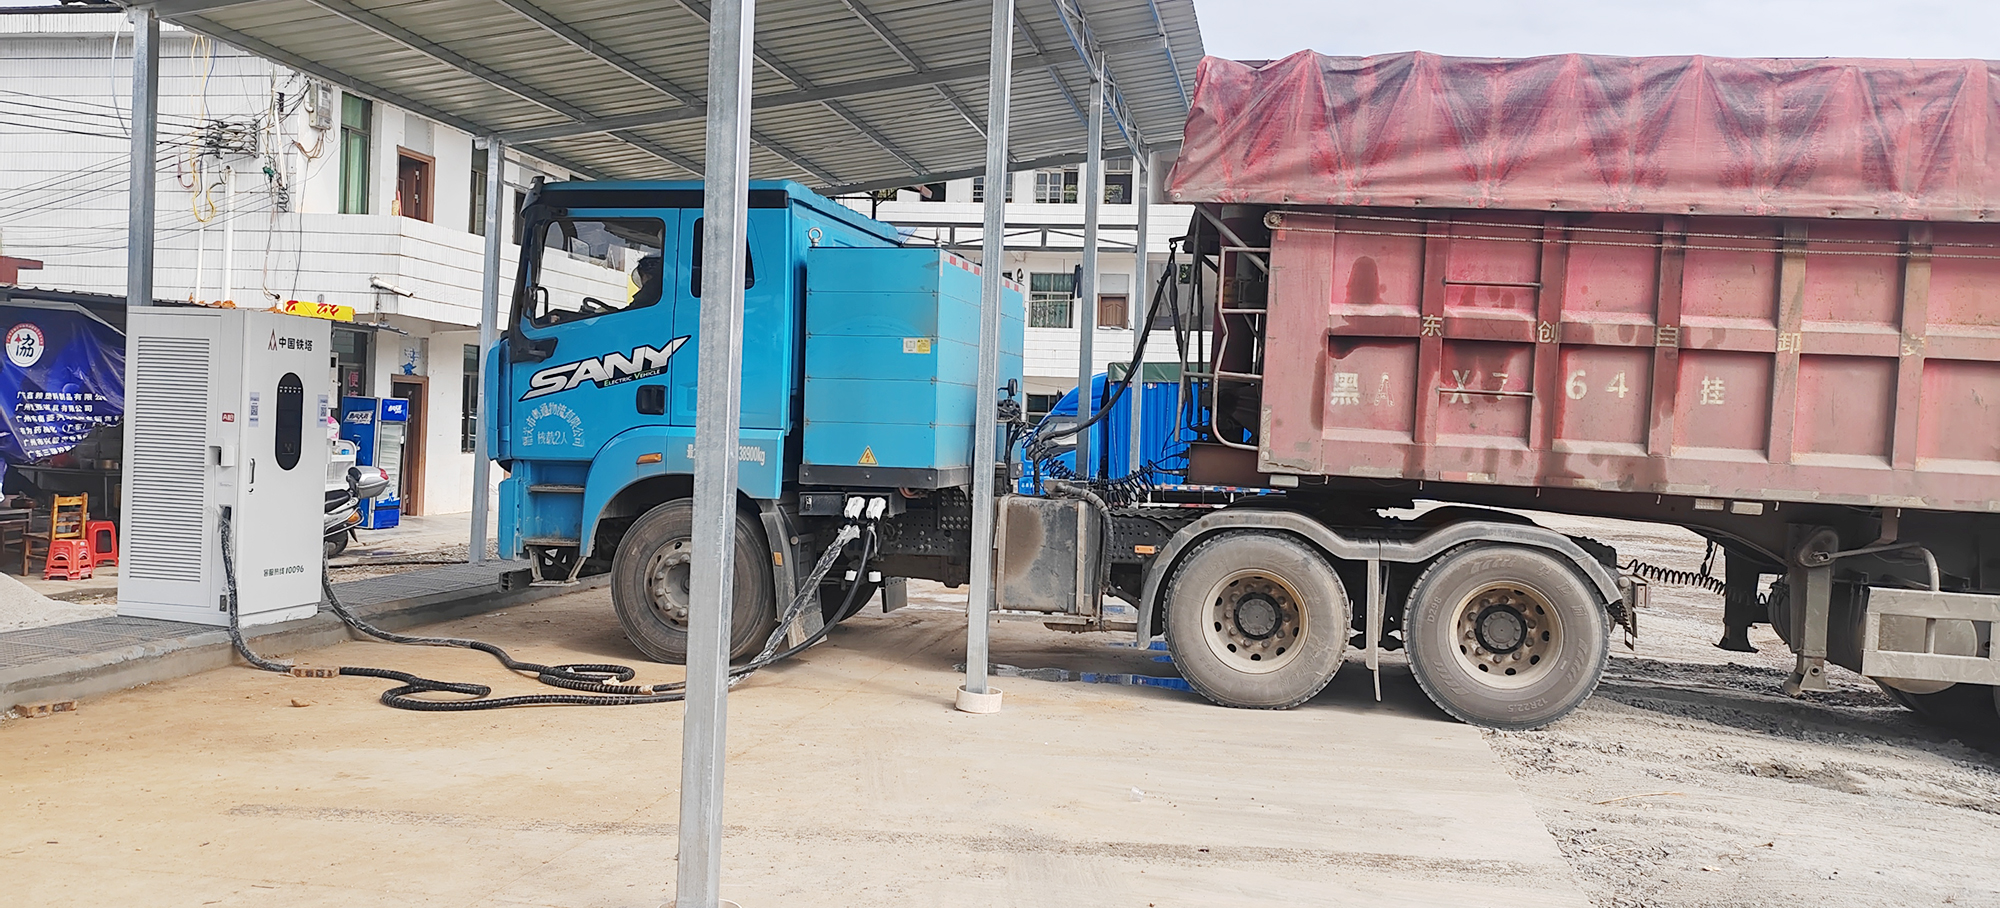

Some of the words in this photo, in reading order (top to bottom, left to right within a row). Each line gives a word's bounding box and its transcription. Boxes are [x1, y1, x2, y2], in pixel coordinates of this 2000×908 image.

[279, 336, 314, 352] 中国铁塔
[519, 335, 692, 402] SANY
[537, 430, 568, 446] 核载2人
